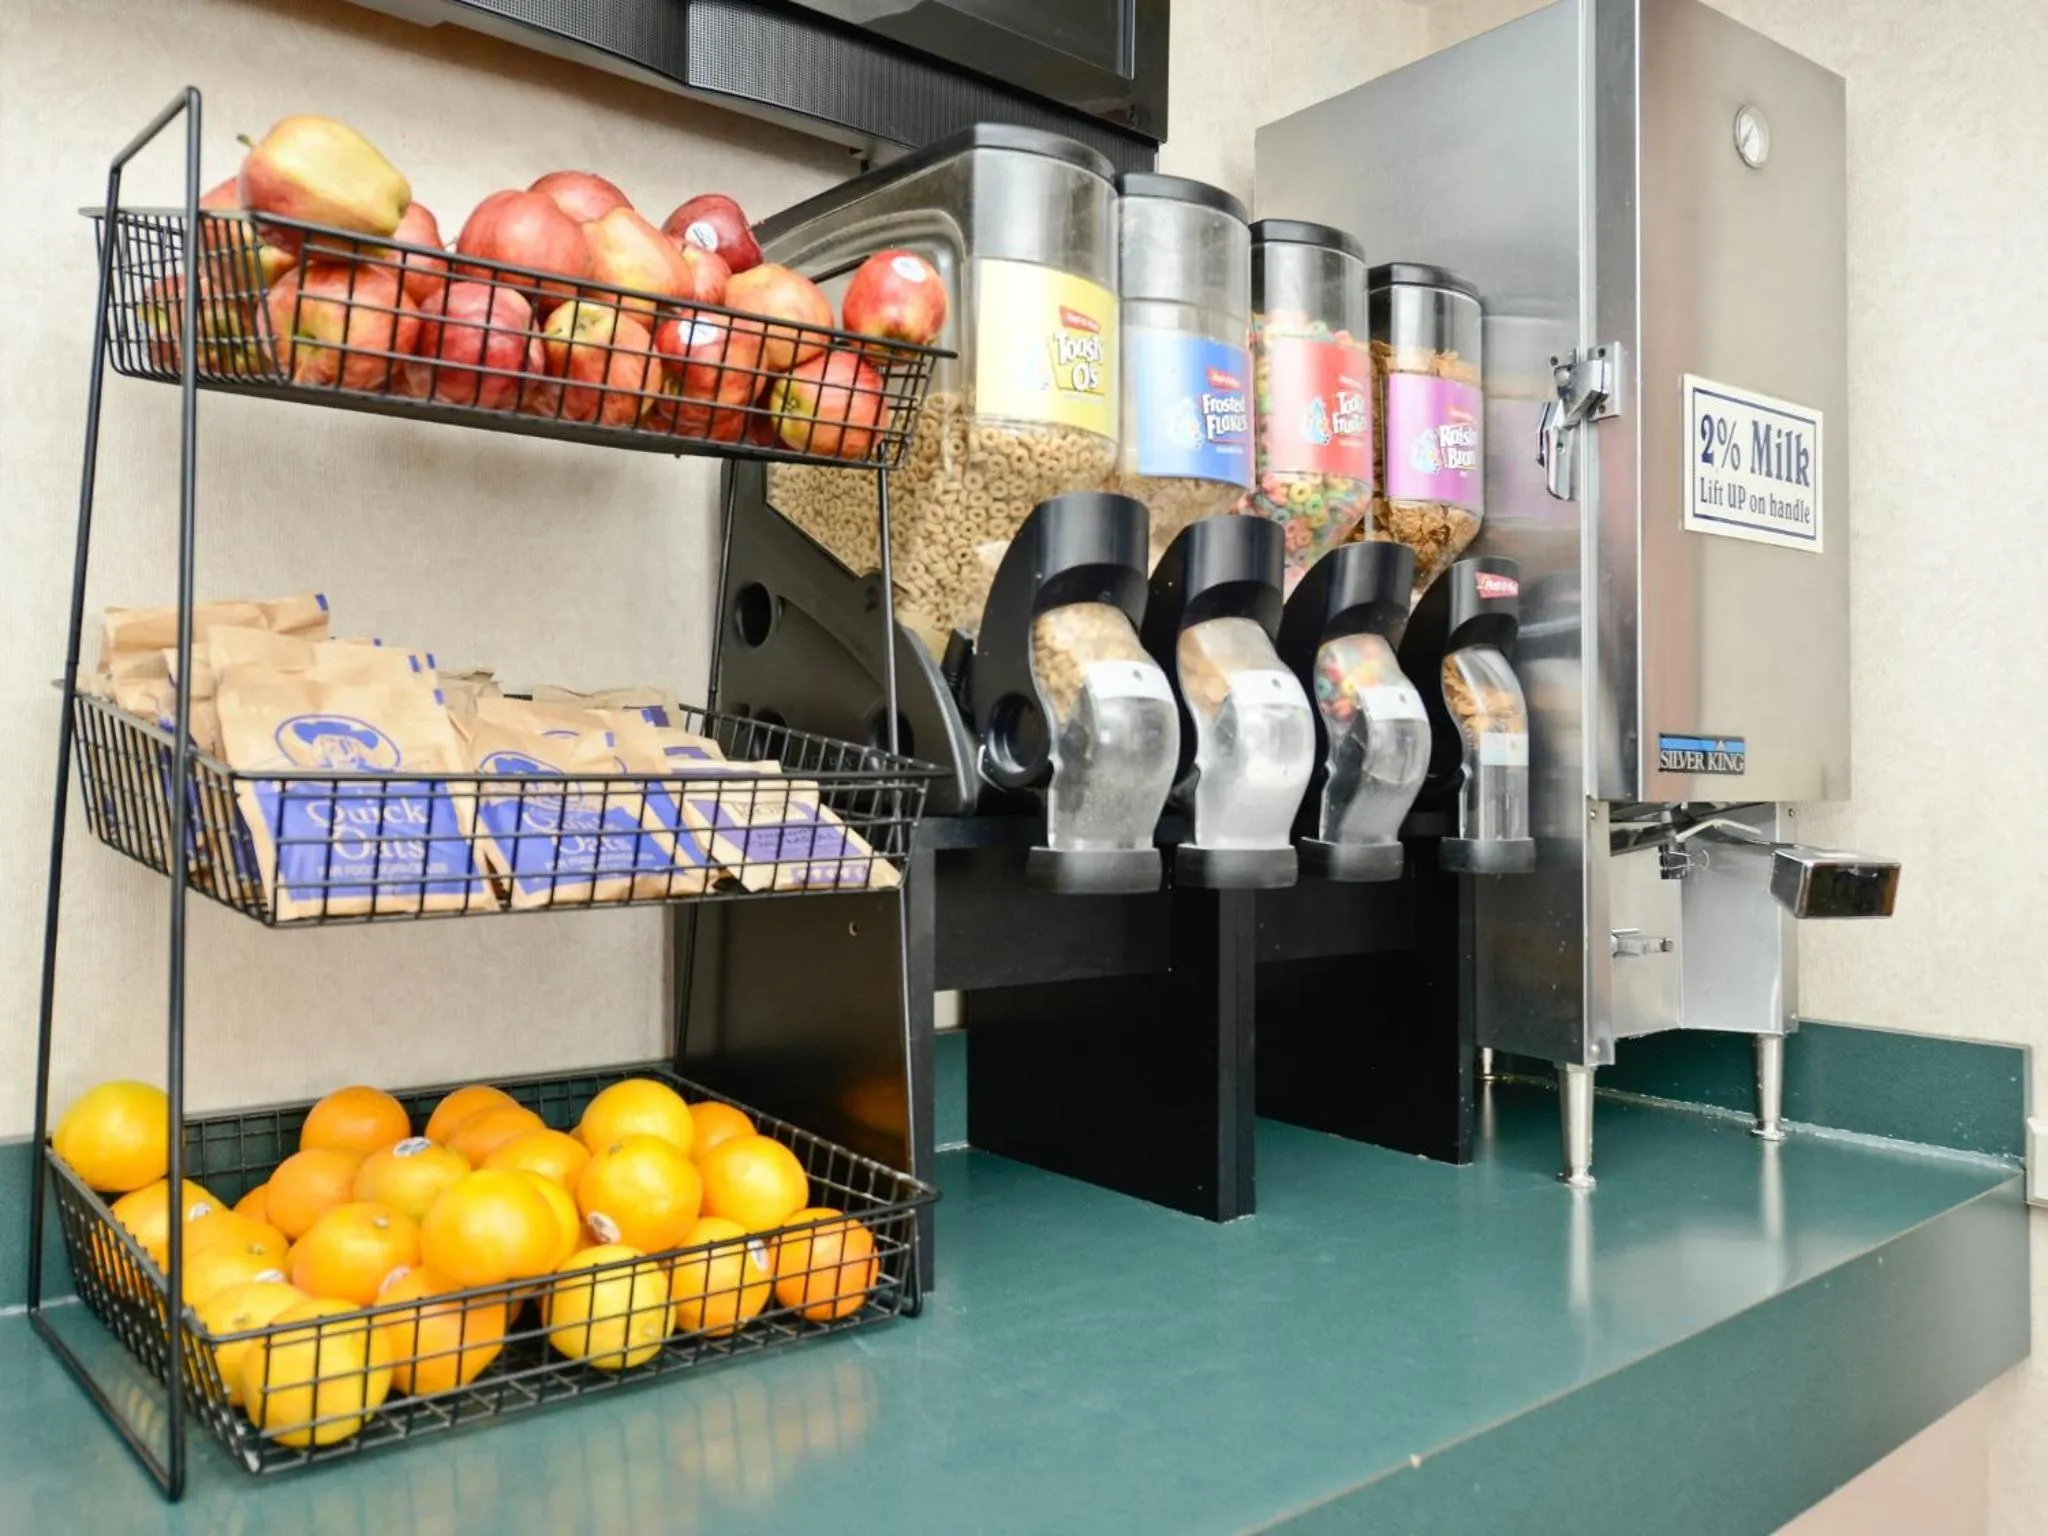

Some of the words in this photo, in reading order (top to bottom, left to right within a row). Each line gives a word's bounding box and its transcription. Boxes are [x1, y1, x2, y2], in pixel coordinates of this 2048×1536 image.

[1201, 392, 1245, 415] Frosted
[1700, 413, 1741, 472] 2%
[1750, 419, 1811, 487] Milk
[1699, 477, 1724, 507] Lift
[1727, 482, 1746, 510] UP
[1749, 494, 1766, 515] on
[1769, 492, 1811, 524] handle
[1660, 750, 1705, 770] SILVER
[1706, 747, 1745, 773] KING
[305, 797, 429, 829] Quick
